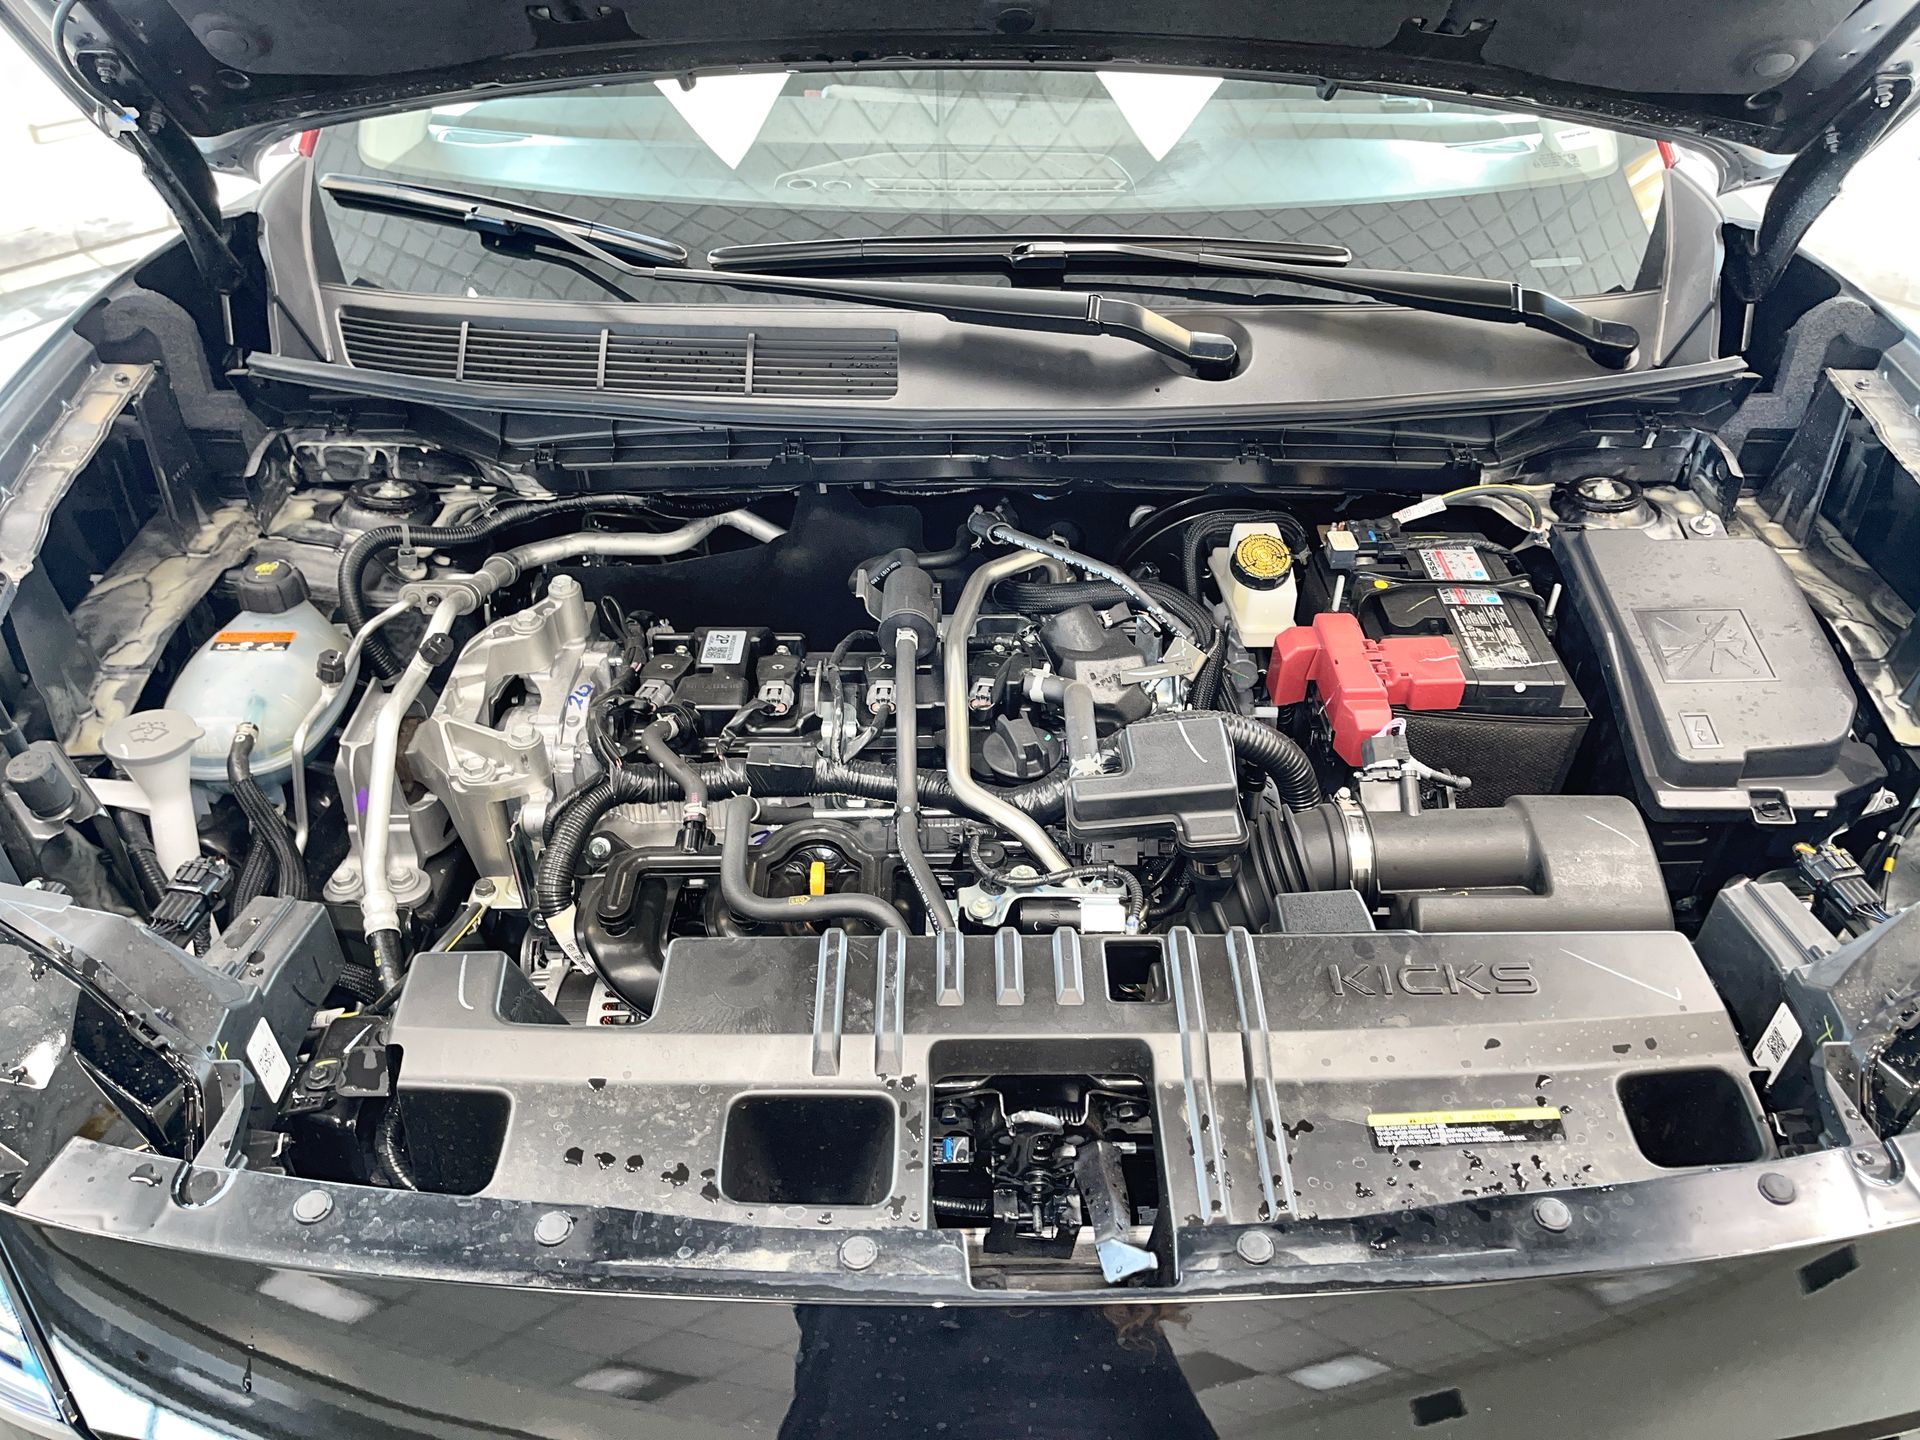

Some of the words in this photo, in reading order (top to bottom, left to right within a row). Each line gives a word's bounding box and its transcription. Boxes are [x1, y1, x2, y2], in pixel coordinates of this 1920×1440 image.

[1423, 551, 1440, 578] NISSAN
[716, 634, 730, 645] 2P
[1327, 962, 1540, 996] KICKS
